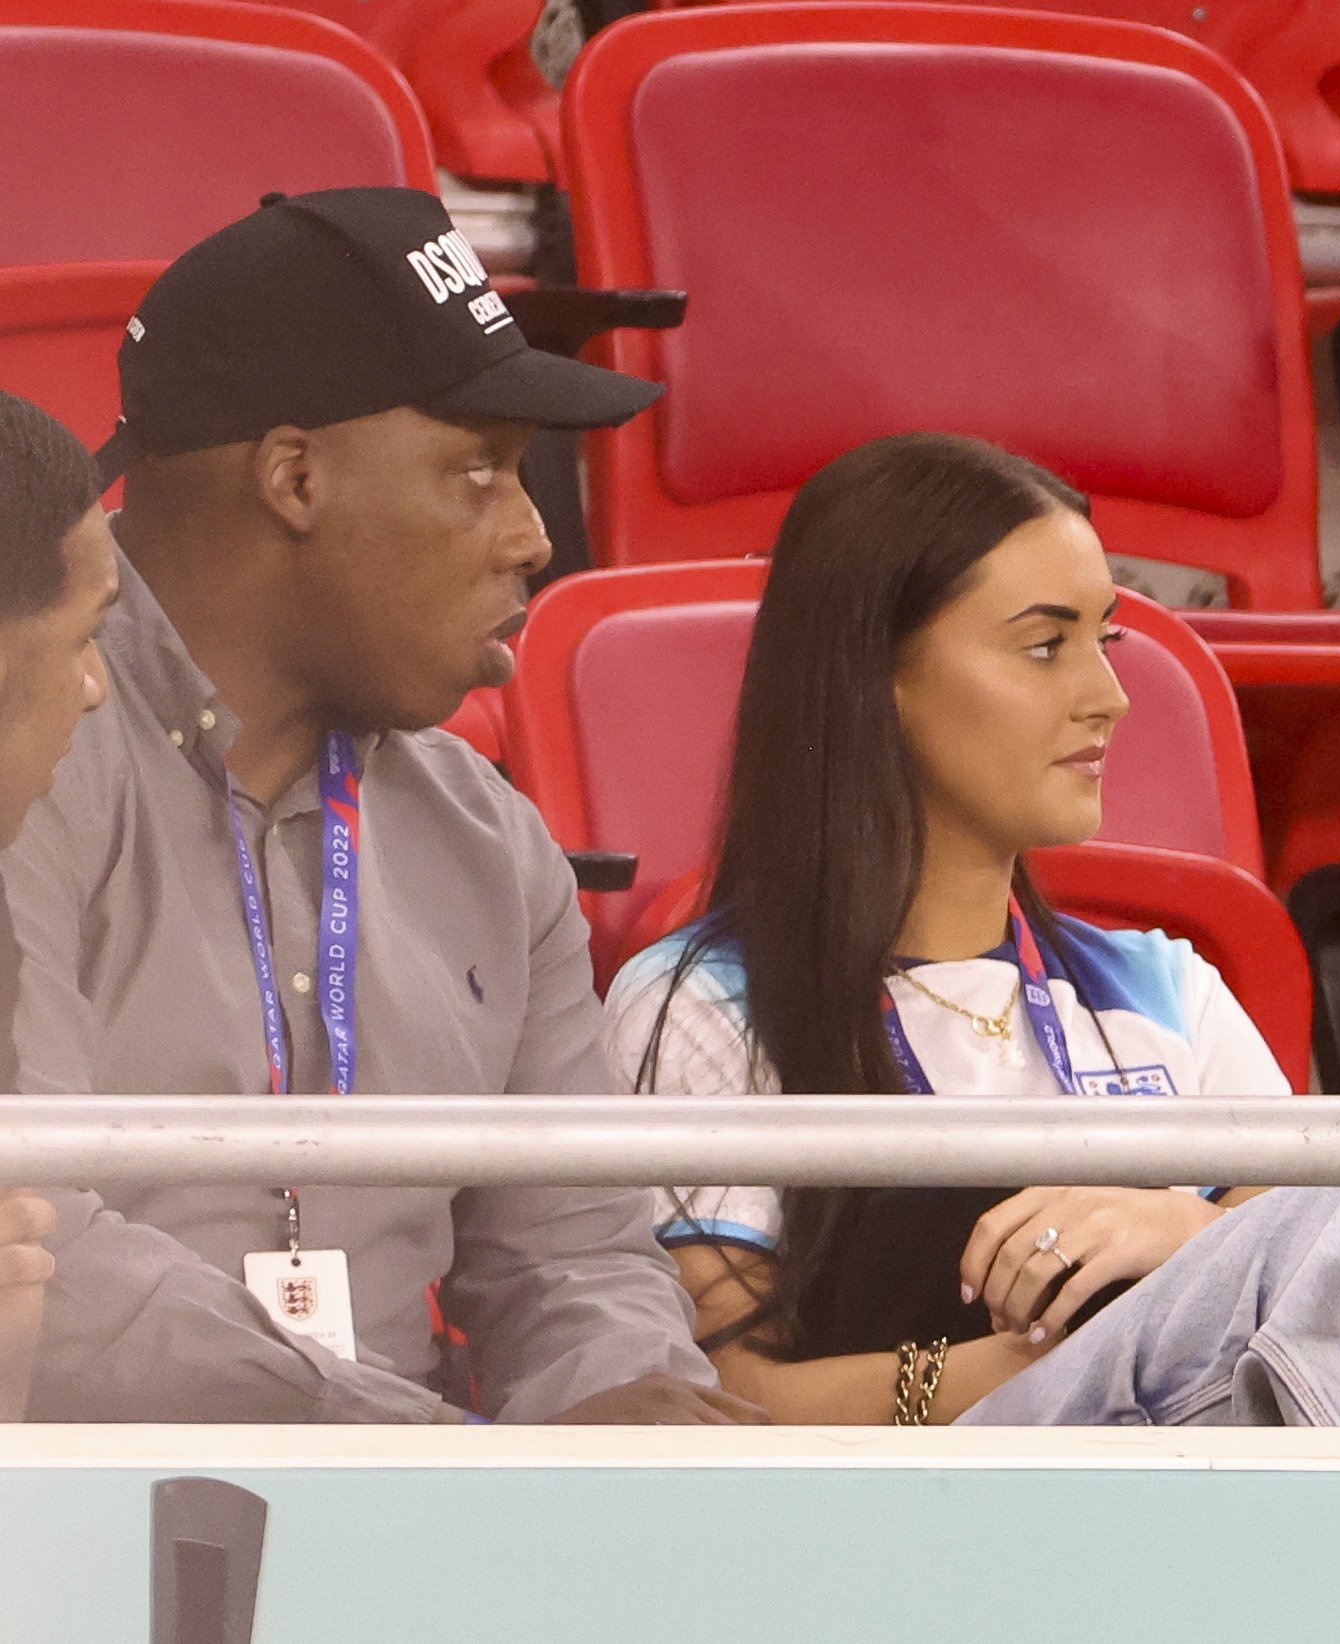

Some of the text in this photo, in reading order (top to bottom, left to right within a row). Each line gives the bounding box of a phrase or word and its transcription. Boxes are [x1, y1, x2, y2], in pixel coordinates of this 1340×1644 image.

[248, 895, 269, 979] WORLD
[328, 824, 350, 1095] QATAR WORLD CUP 2022
[265, 990, 282, 1070] QATAR
